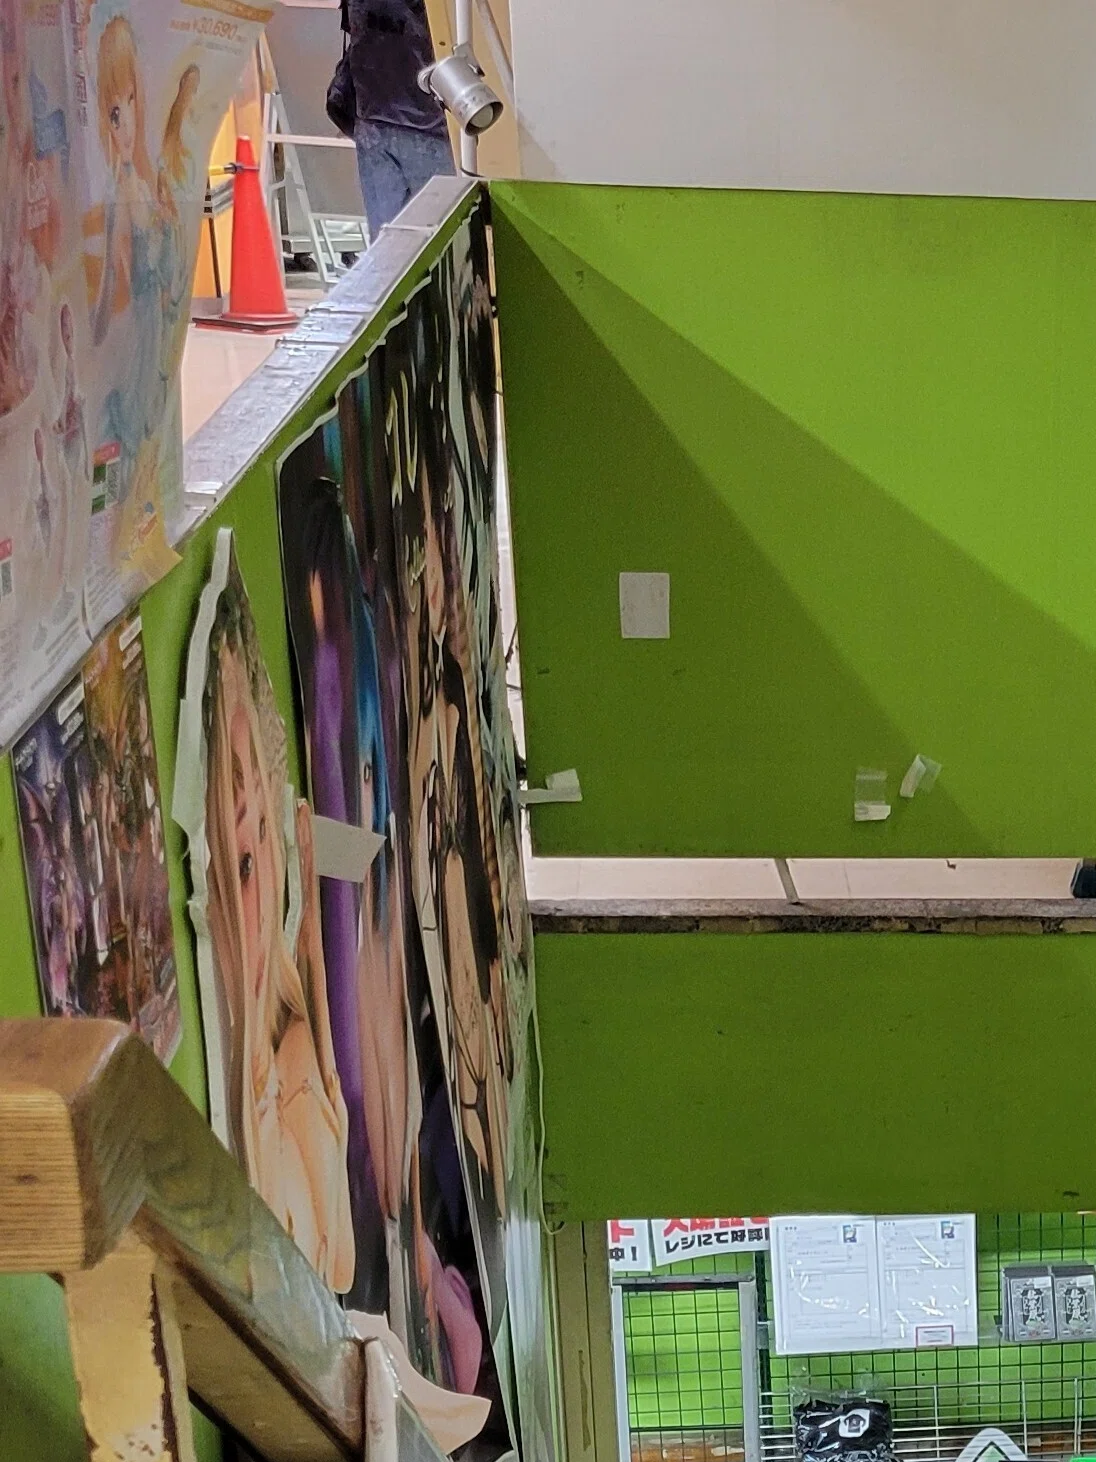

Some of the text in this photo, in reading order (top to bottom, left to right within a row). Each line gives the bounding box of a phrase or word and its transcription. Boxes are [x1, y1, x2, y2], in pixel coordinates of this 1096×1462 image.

[665, 1228, 769, 1254] レジにて好評
